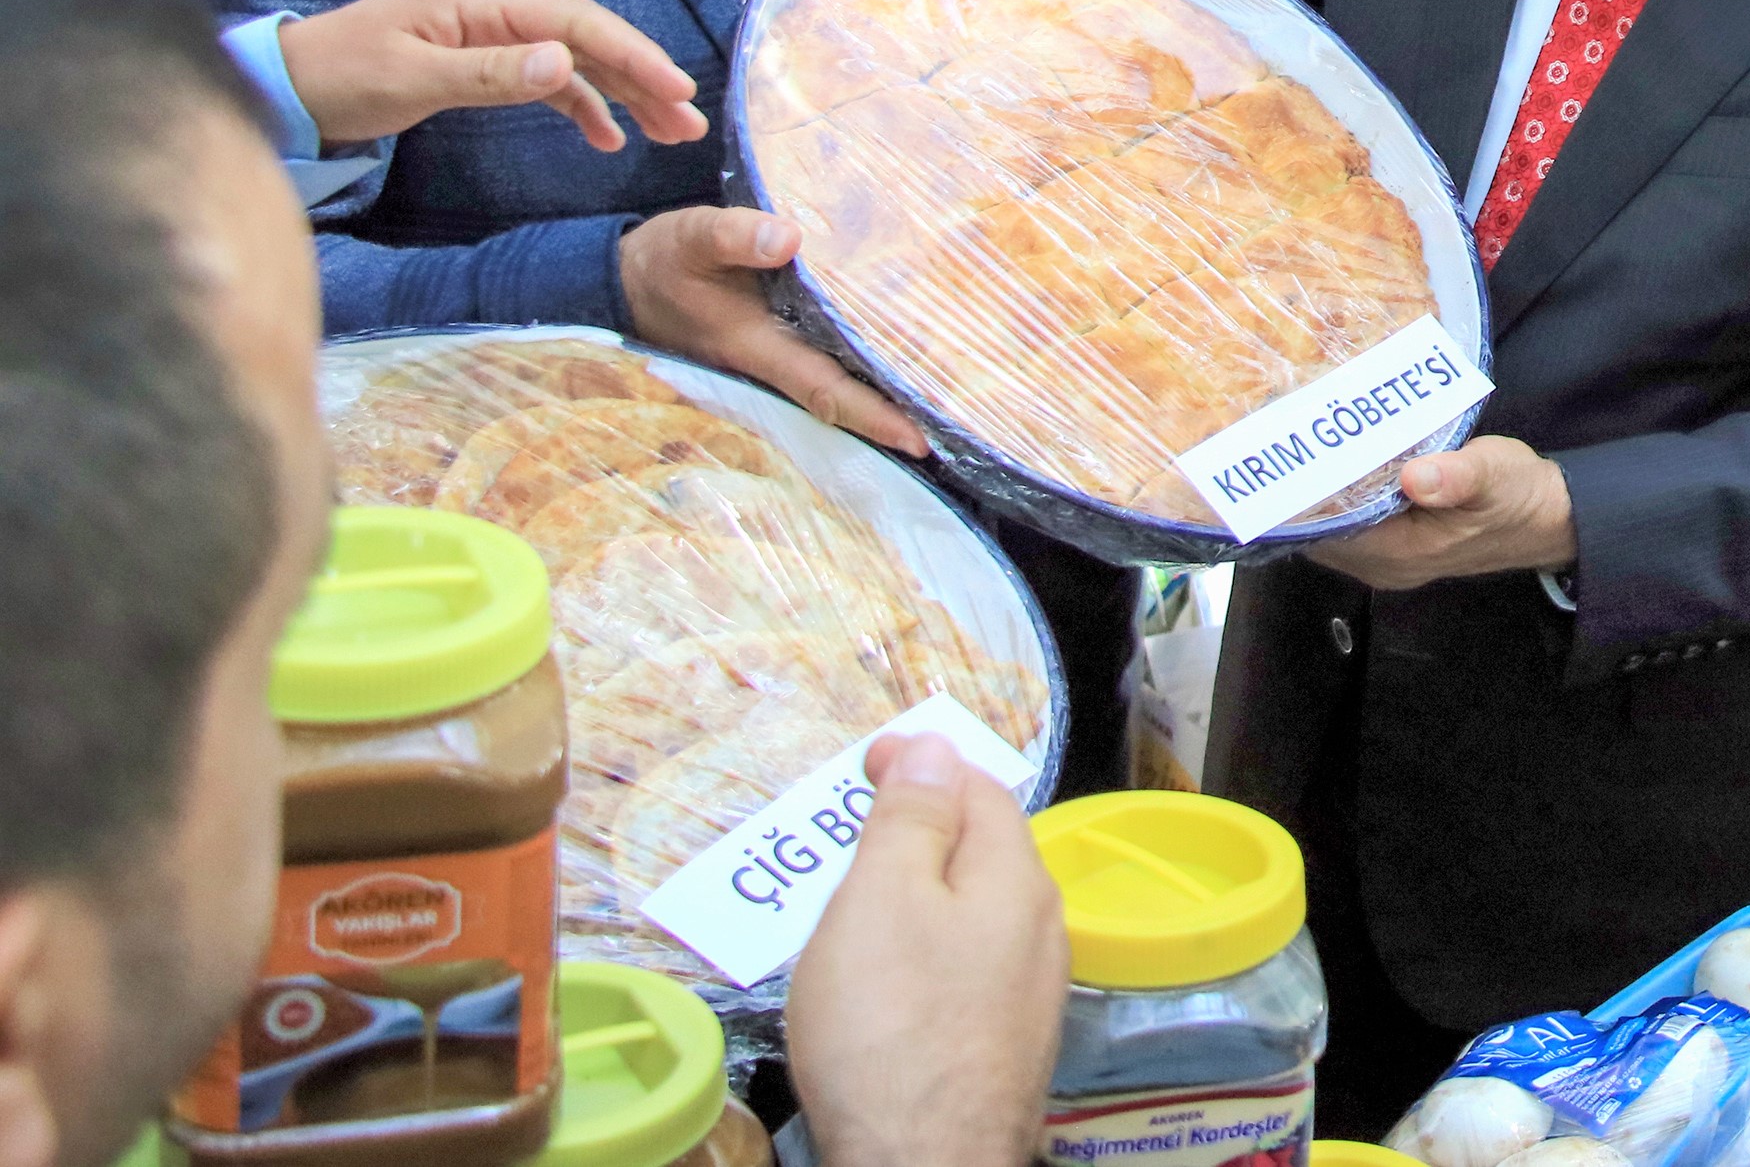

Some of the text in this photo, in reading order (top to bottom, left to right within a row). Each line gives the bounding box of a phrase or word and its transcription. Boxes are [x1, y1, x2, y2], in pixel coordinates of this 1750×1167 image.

[1212, 344, 1462, 503] KIRIM GÖBETE'Sİ
[731, 826, 824, 912] ÇİĞ
[1051, 1110, 1293, 1160] Değirmenci Kardeşler
